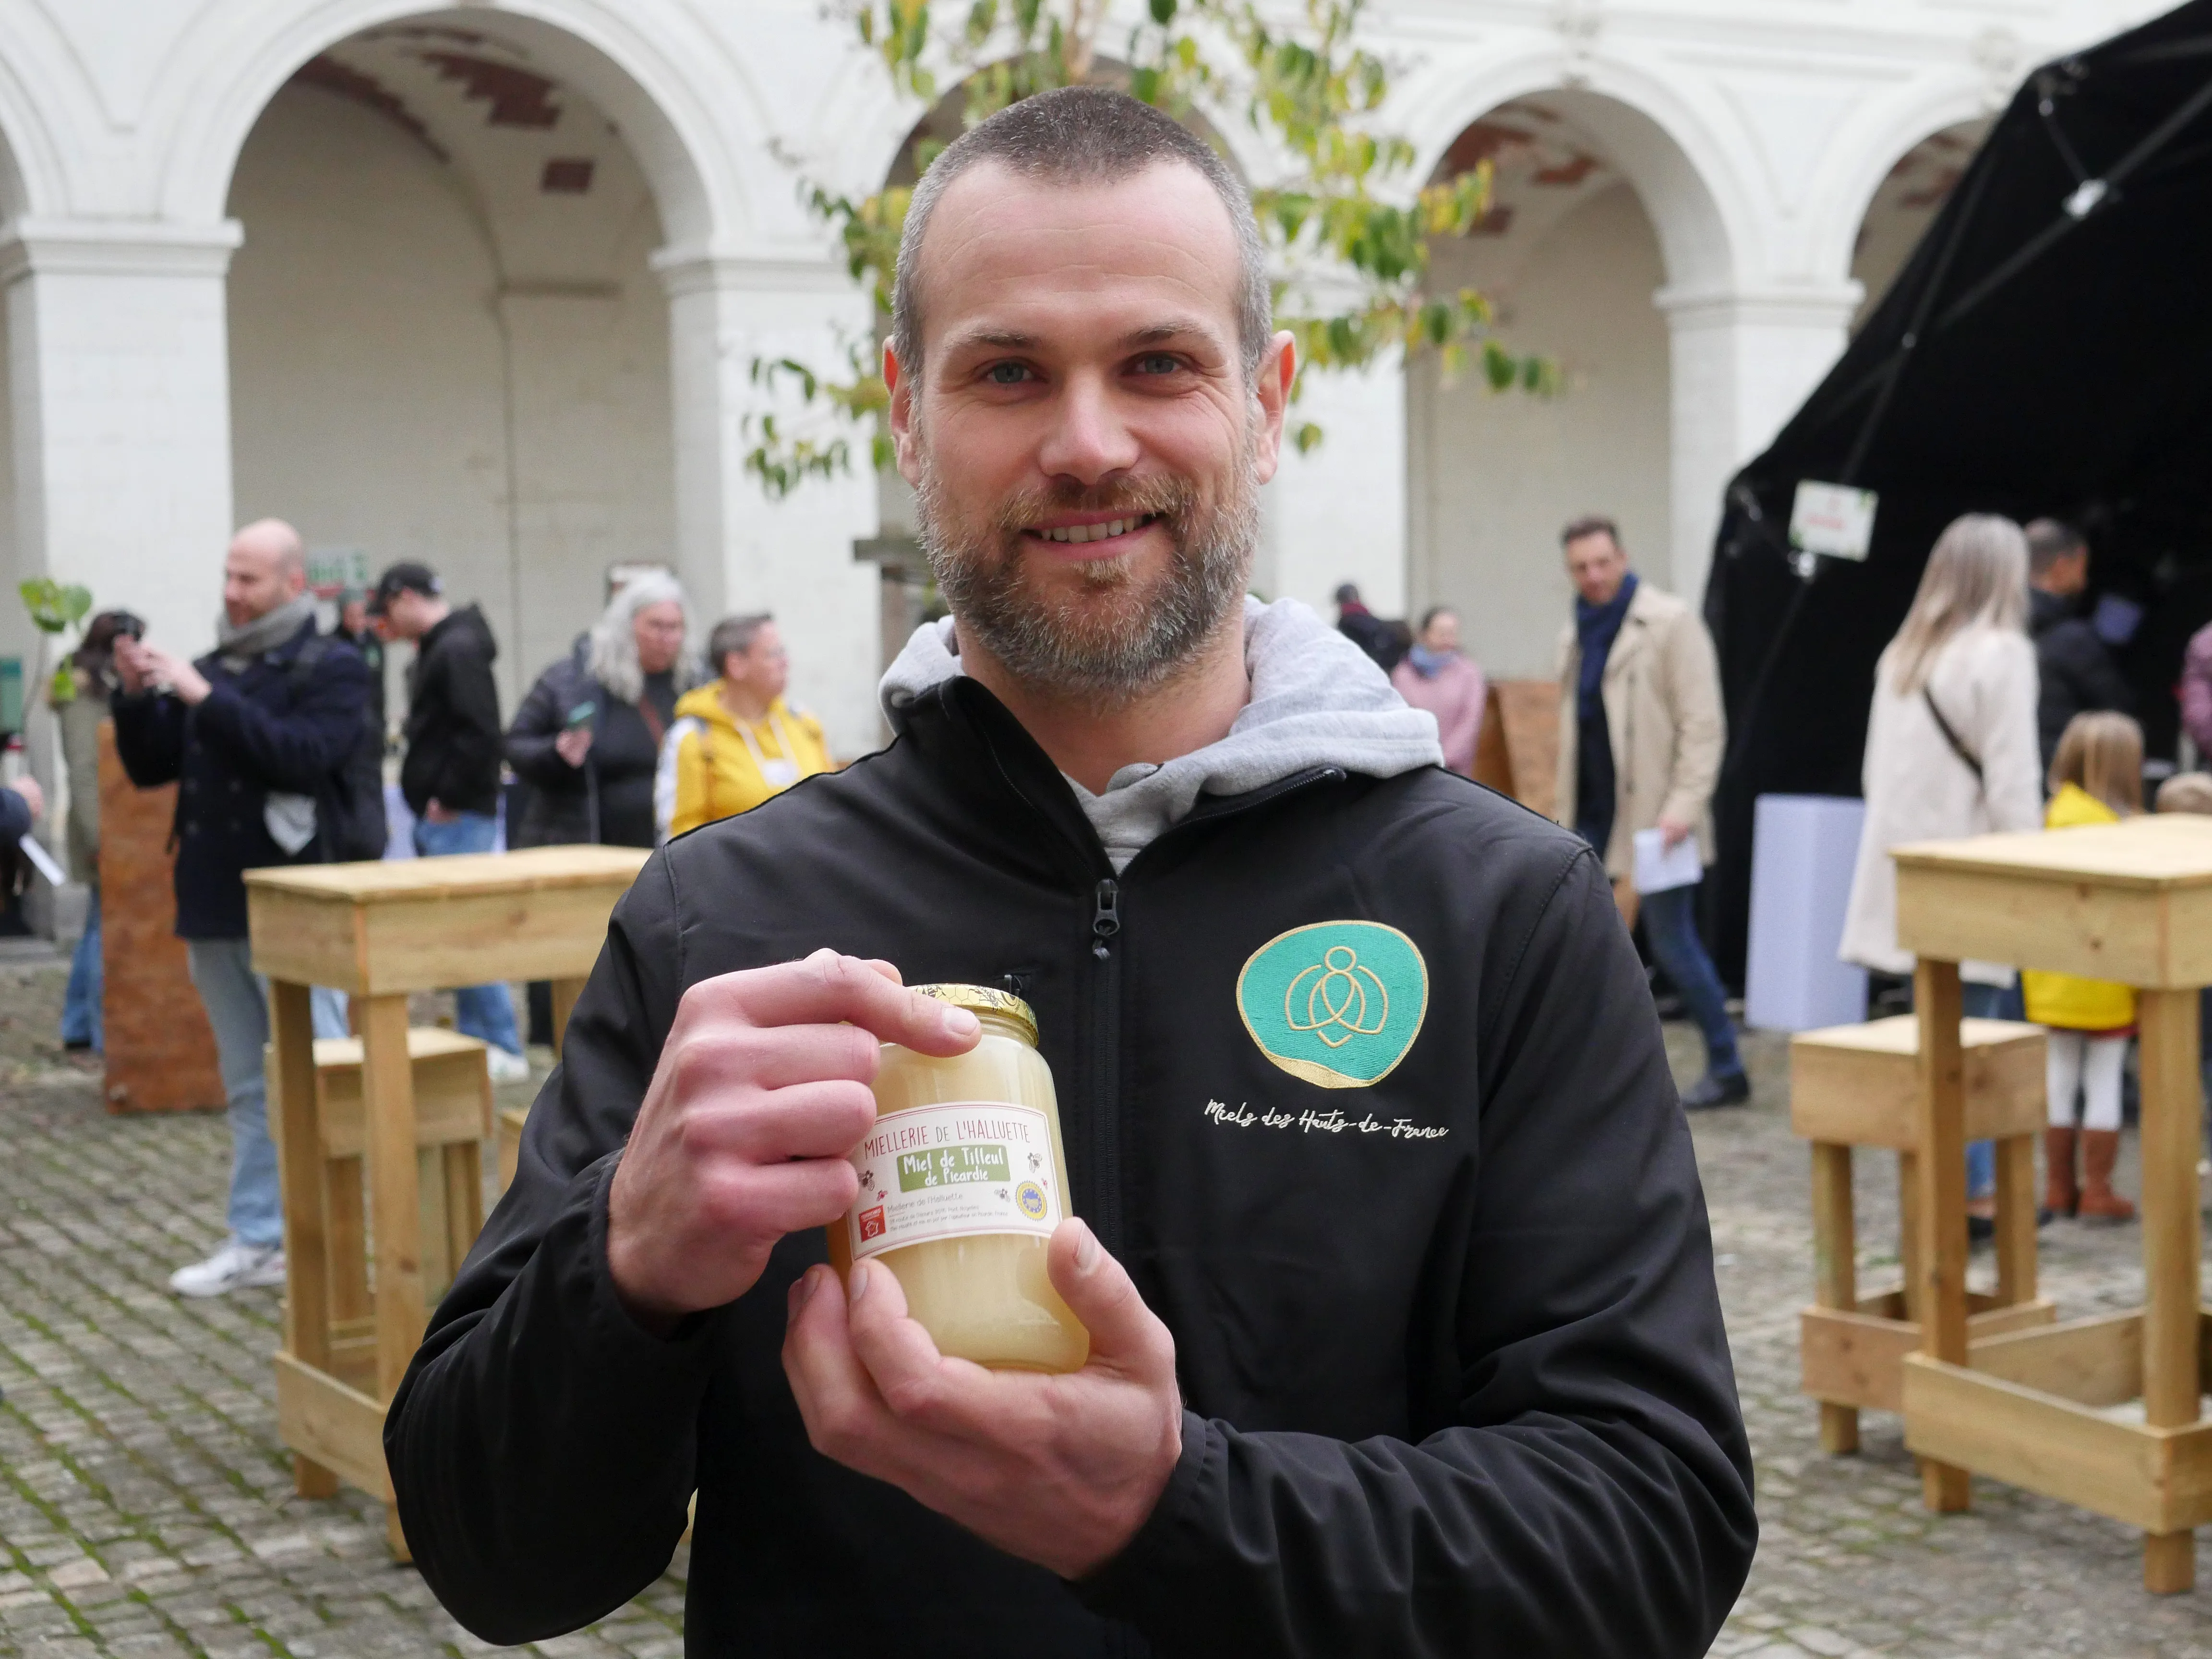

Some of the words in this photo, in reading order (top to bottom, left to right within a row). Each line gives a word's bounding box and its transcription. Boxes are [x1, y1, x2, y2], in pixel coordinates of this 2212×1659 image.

[1204, 1099, 1257, 1127] Miels
[1261, 1107, 1295, 1128] des
[1298, 1109, 1449, 1139] Hauts-de-France
[865, 1125, 929, 1159] MIELLERIE
[936, 1126, 950, 1143] DE
[956, 1119, 1030, 1143] L'HALLUETTE
[903, 1152, 933, 1175] Miel
[940, 1148, 955, 1167] de
[961, 1146, 1003, 1166] Tilleul
[925, 1169, 938, 1187] de
[943, 1165, 988, 1184] Picardie
